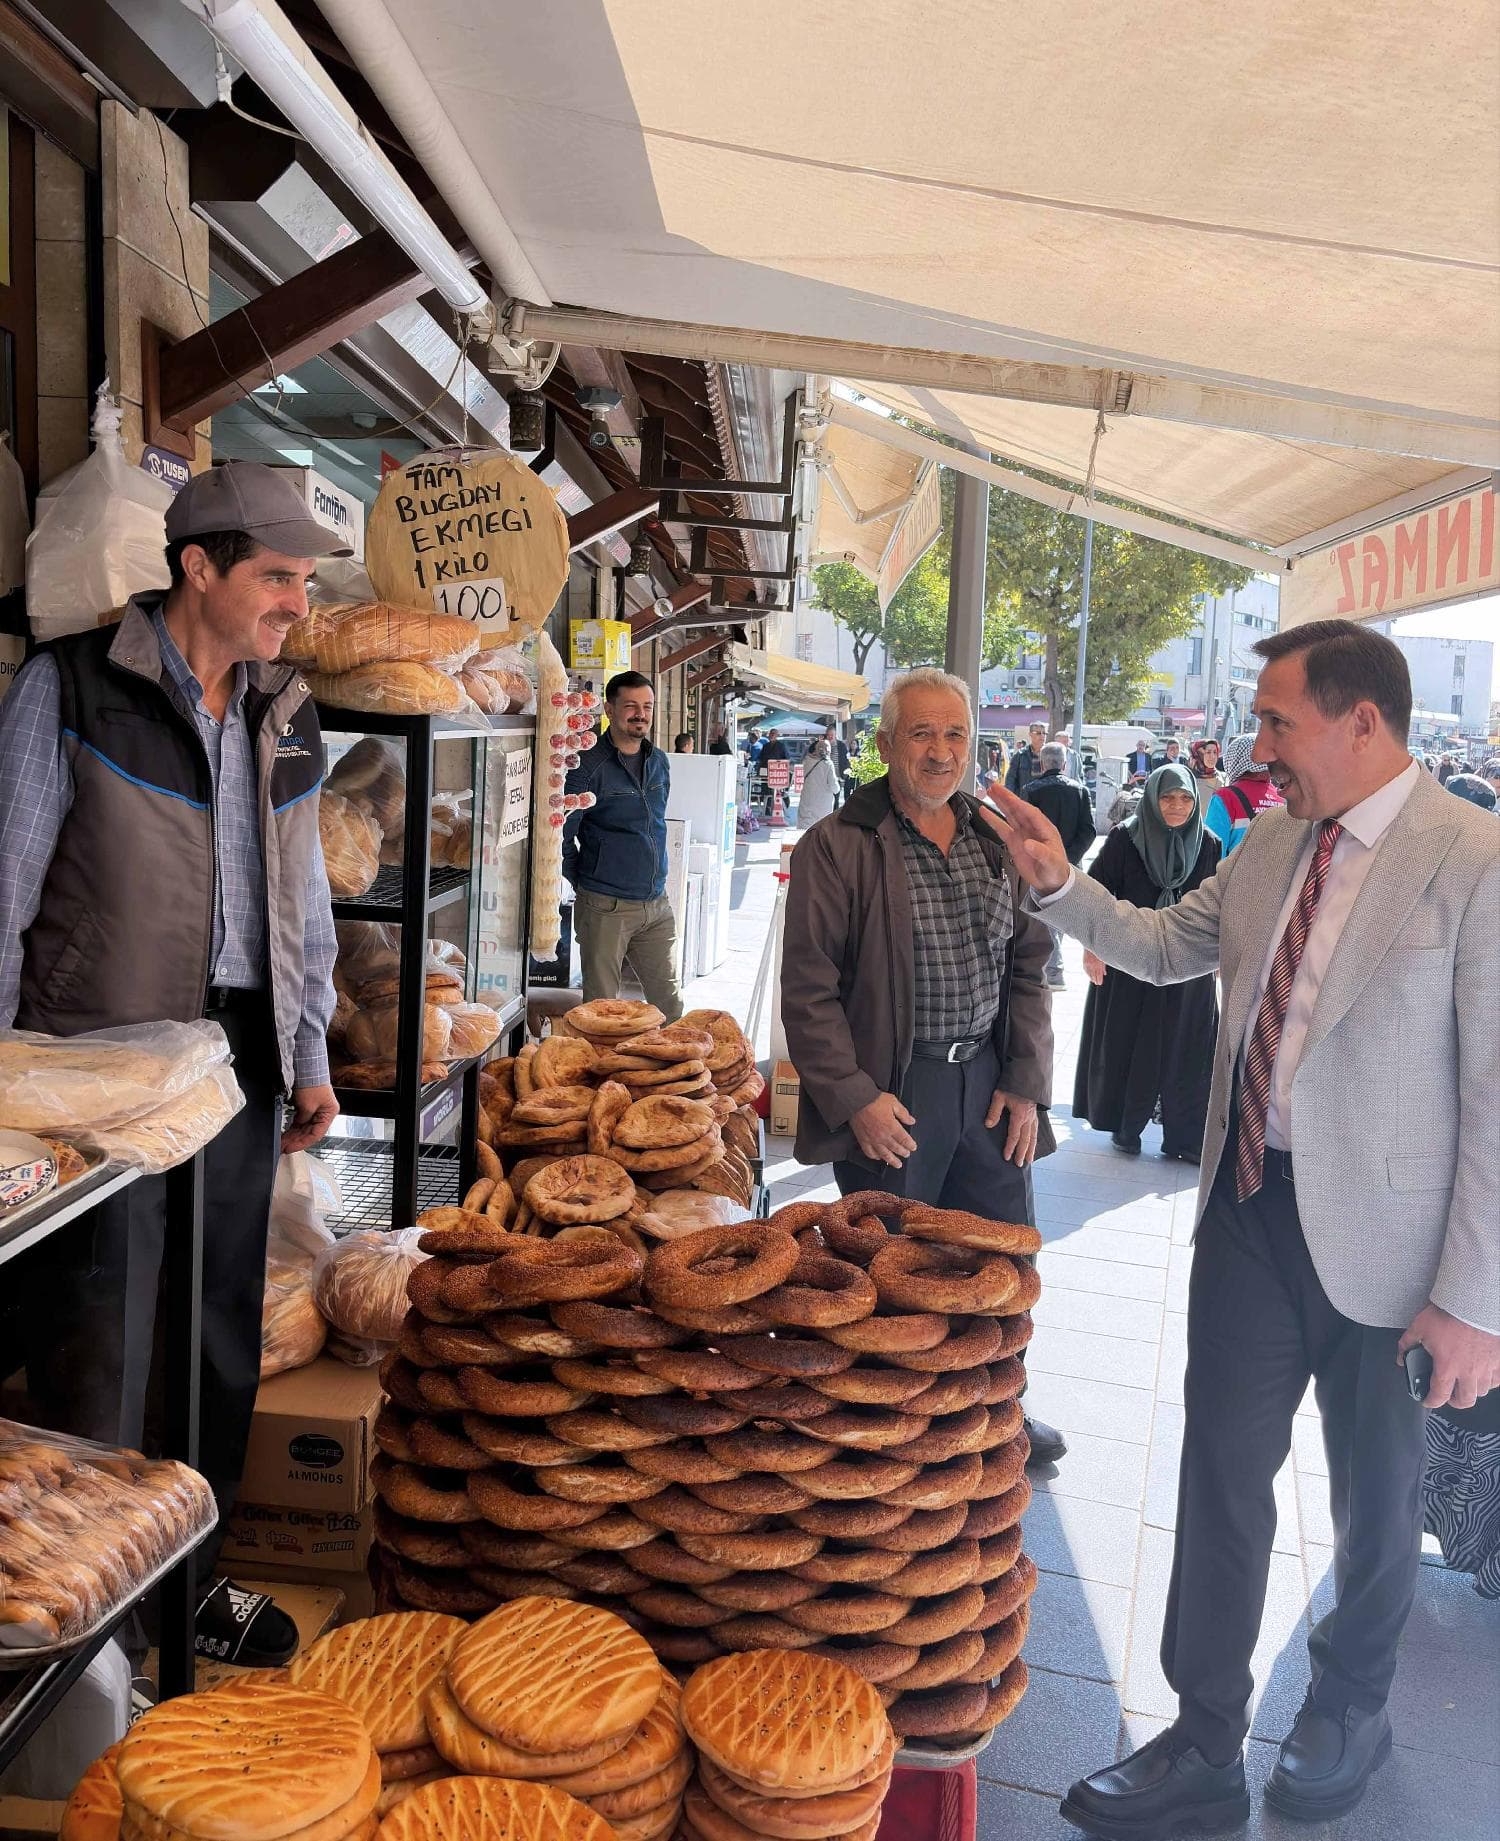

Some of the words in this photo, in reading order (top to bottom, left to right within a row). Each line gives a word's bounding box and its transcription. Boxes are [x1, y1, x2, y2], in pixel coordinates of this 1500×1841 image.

[405, 466, 463, 491] TAM
[395, 482, 501, 523] BUGDAY
[414, 559, 426, 588] 1
[439, 585, 502, 620] 100
[287, 1470, 344, 1485] ALMONDS
